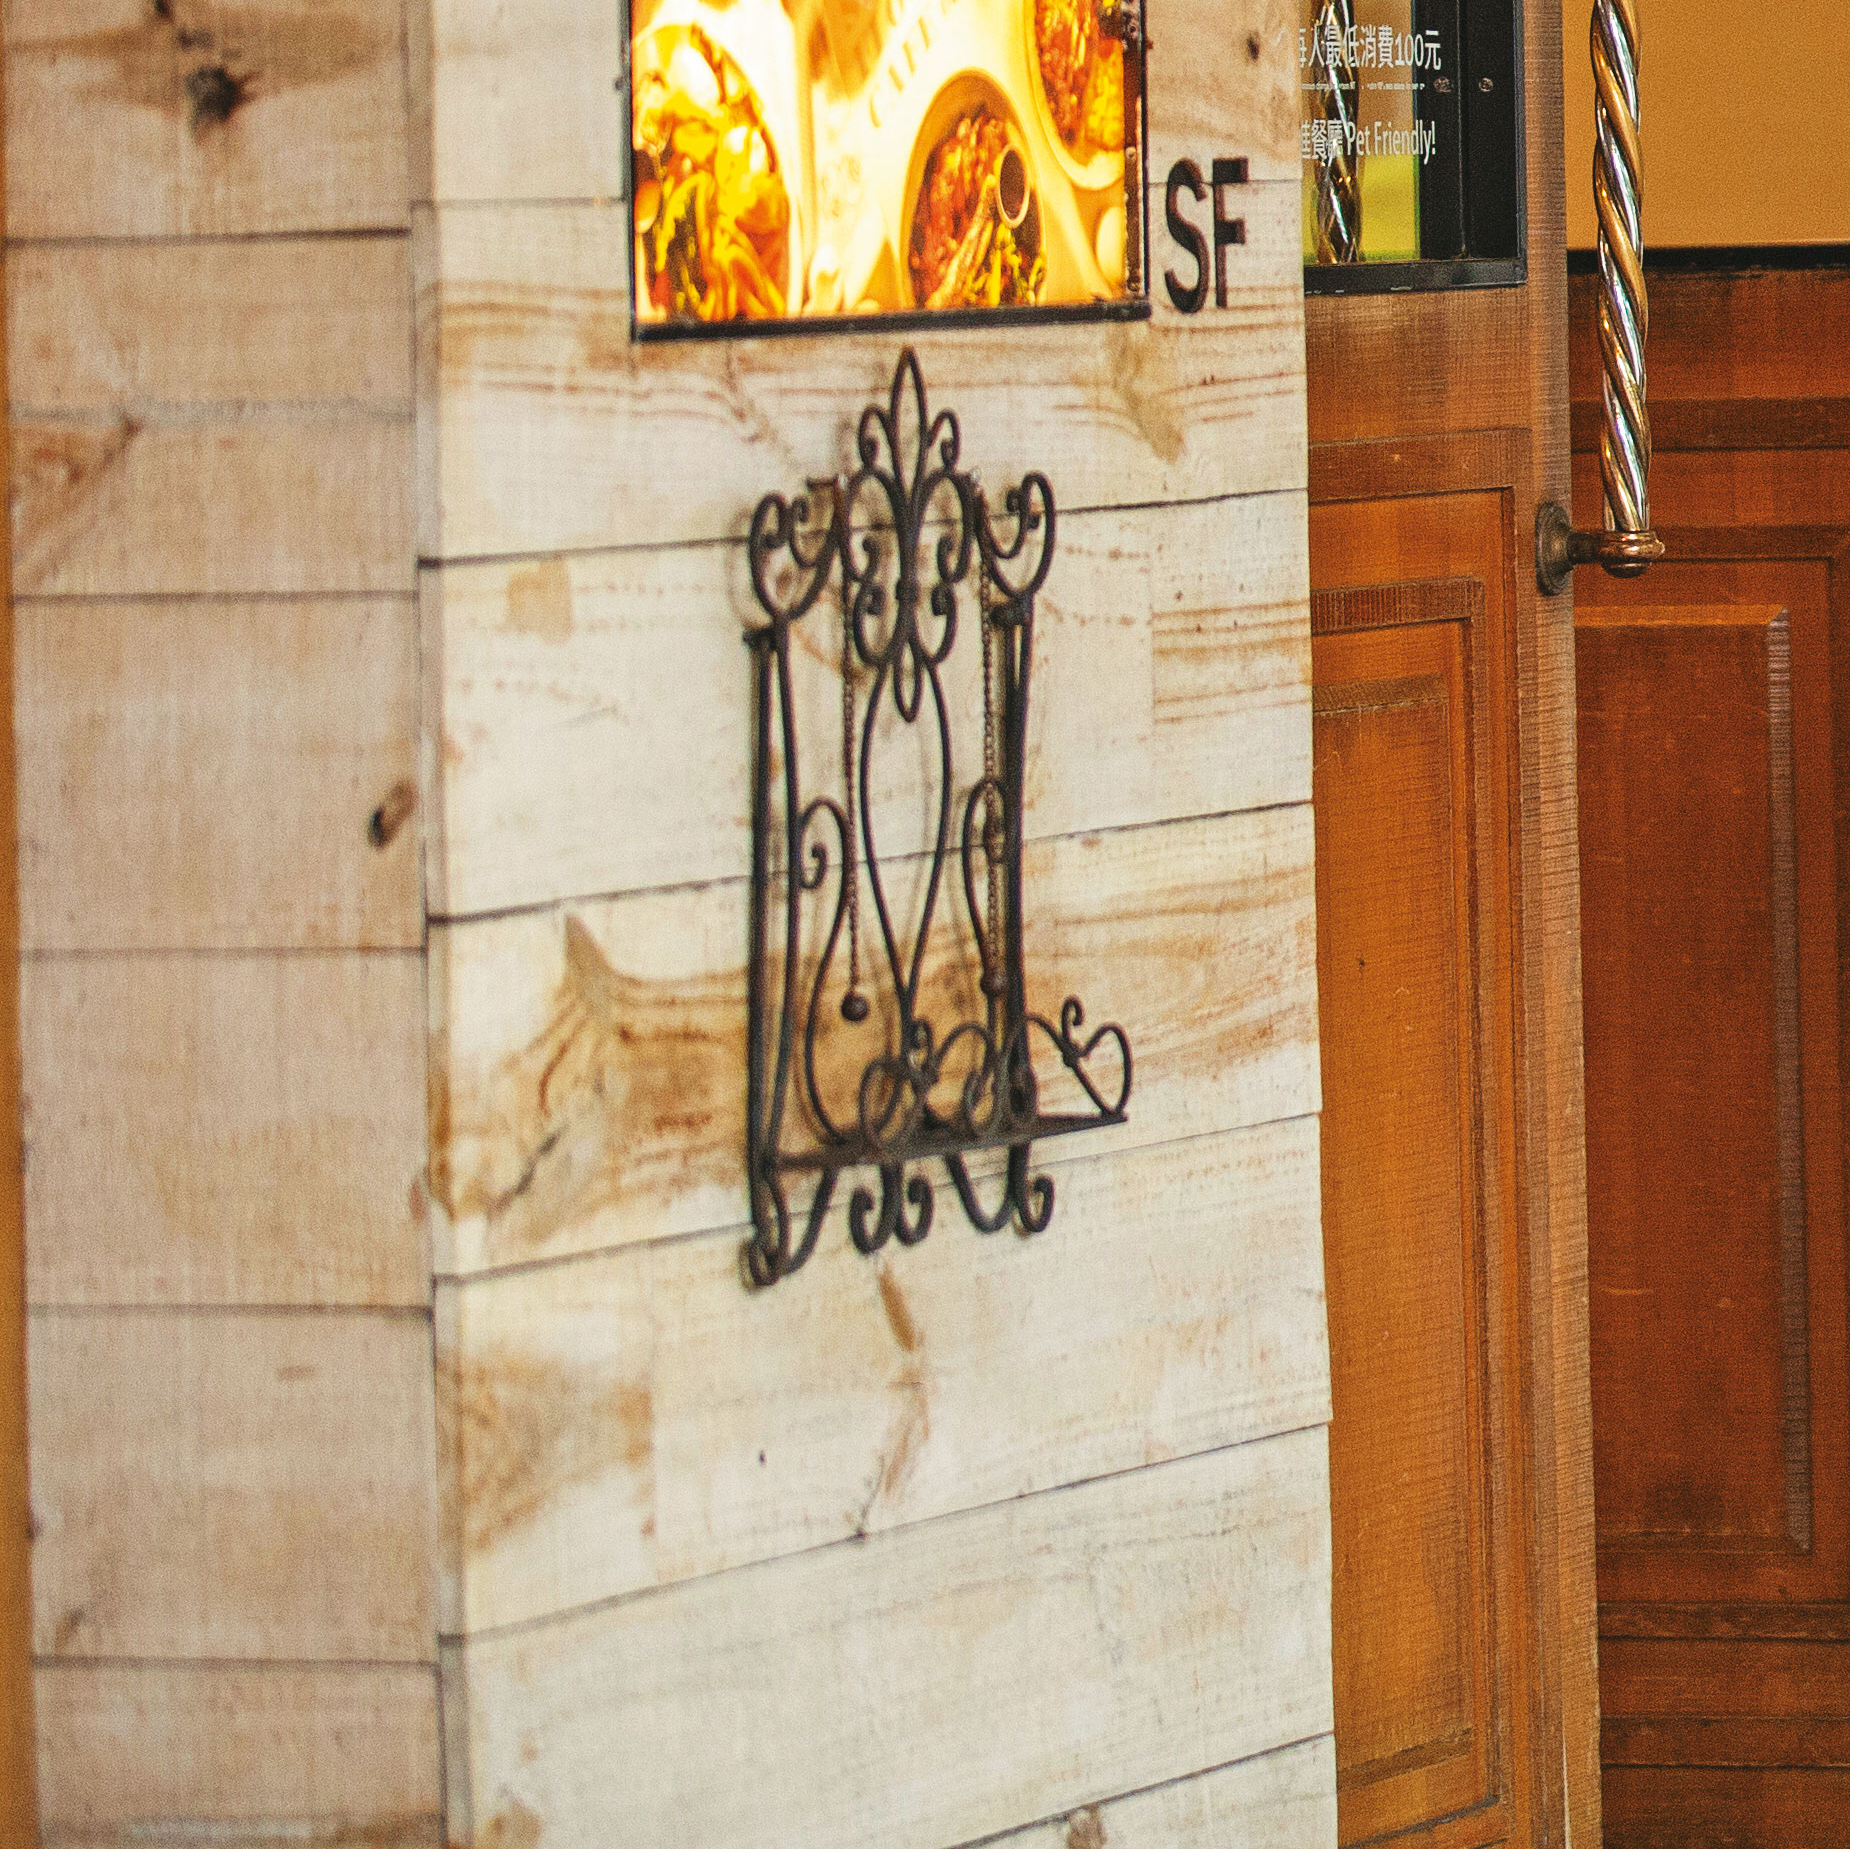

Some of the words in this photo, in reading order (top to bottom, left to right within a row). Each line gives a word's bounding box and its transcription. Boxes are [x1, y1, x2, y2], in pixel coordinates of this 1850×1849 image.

[1347, 120, 1370, 156] Pet
[1373, 119, 1436, 165] Friendly!
[1164, 157, 1249, 313] SF
